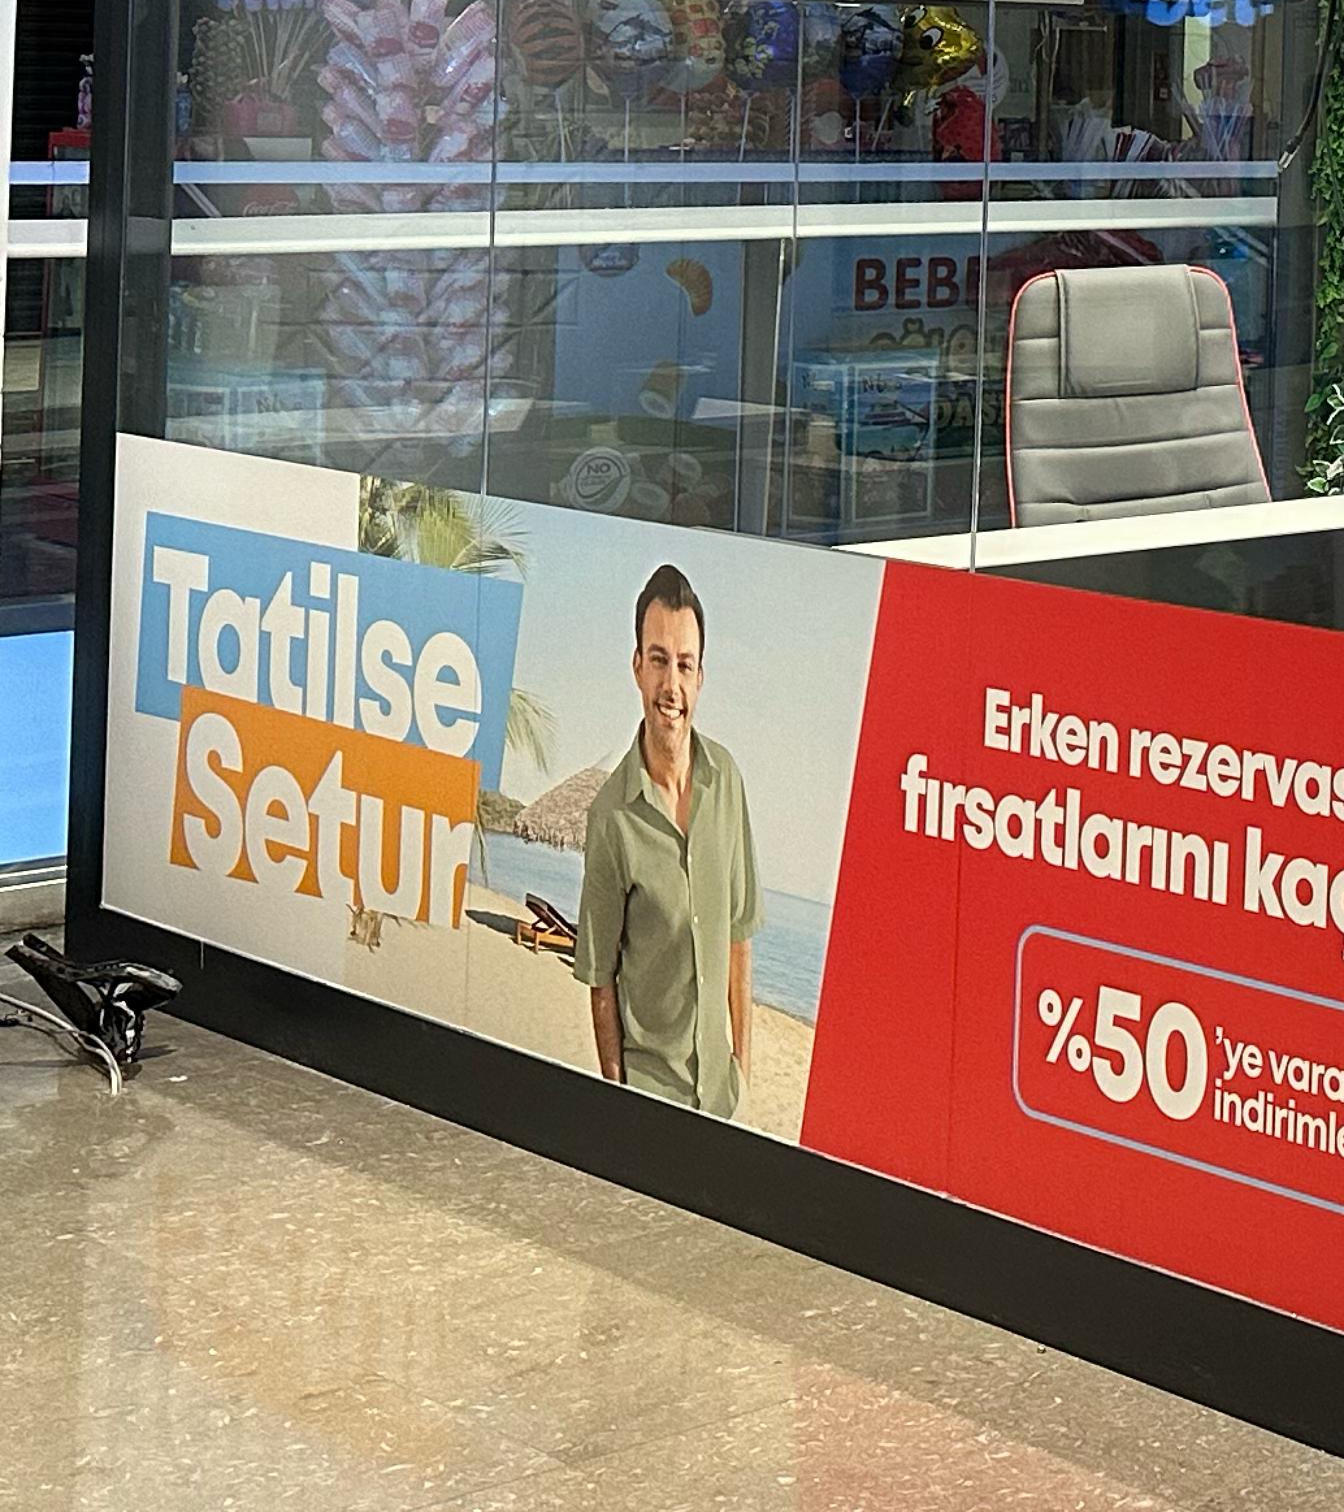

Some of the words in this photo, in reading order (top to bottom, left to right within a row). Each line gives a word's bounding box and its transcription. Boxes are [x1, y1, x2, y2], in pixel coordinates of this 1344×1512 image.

[153, 546, 482, 757] Tatilse
[984, 687, 1119, 773] Erken
[183, 712, 475, 930] Setur
[900, 753, 1229, 905] fırsatlarını
